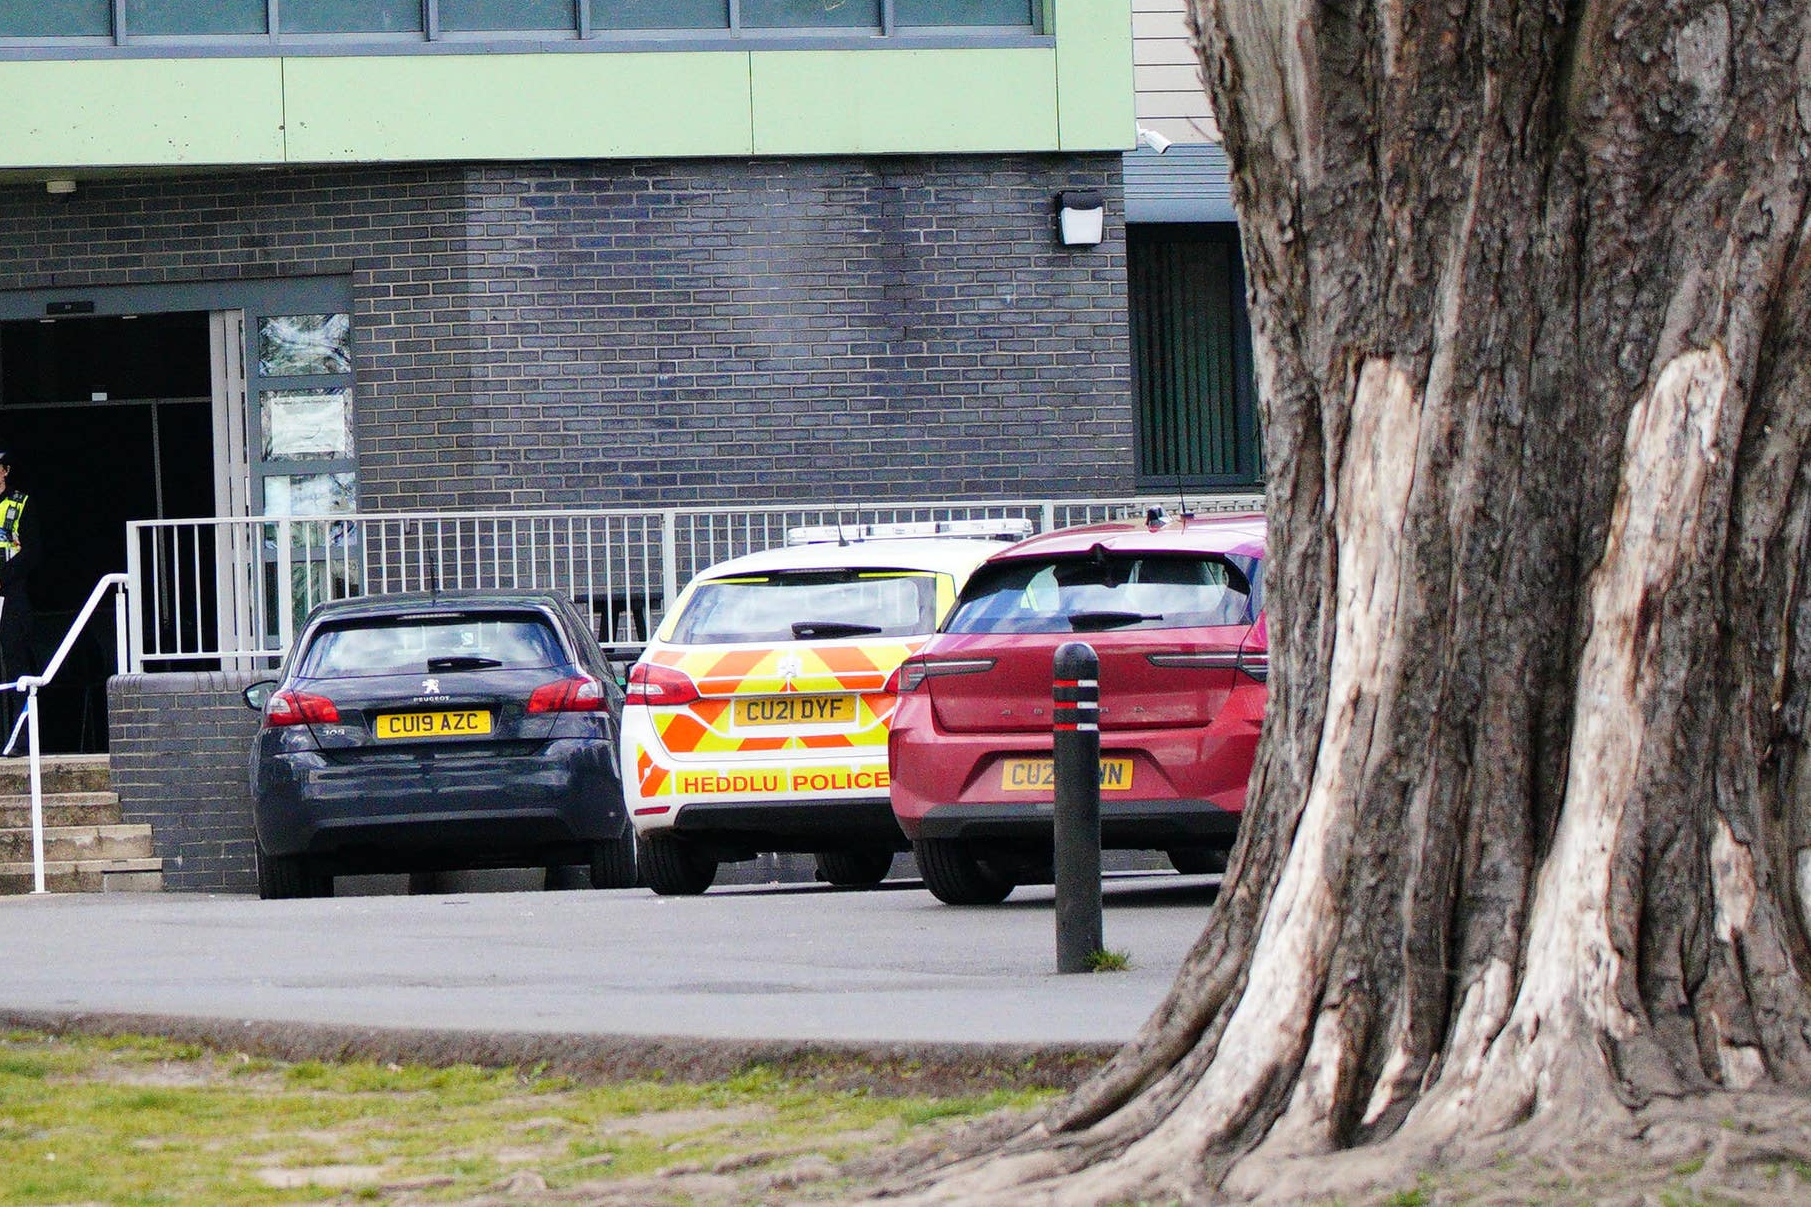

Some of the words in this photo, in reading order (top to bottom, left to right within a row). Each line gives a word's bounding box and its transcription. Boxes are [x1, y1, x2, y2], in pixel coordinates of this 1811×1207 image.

[413, 695, 450, 703] PEUGEOT
[747, 700, 794, 721] CU21
[801, 699, 843, 718] DYF
[390, 715, 433, 734] CU19
[441, 713, 478, 731] AZC
[684, 776, 778, 793] HEDDLU
[793, 771, 890, 791] POLICE
[1012, 763, 1054, 784] CU2
